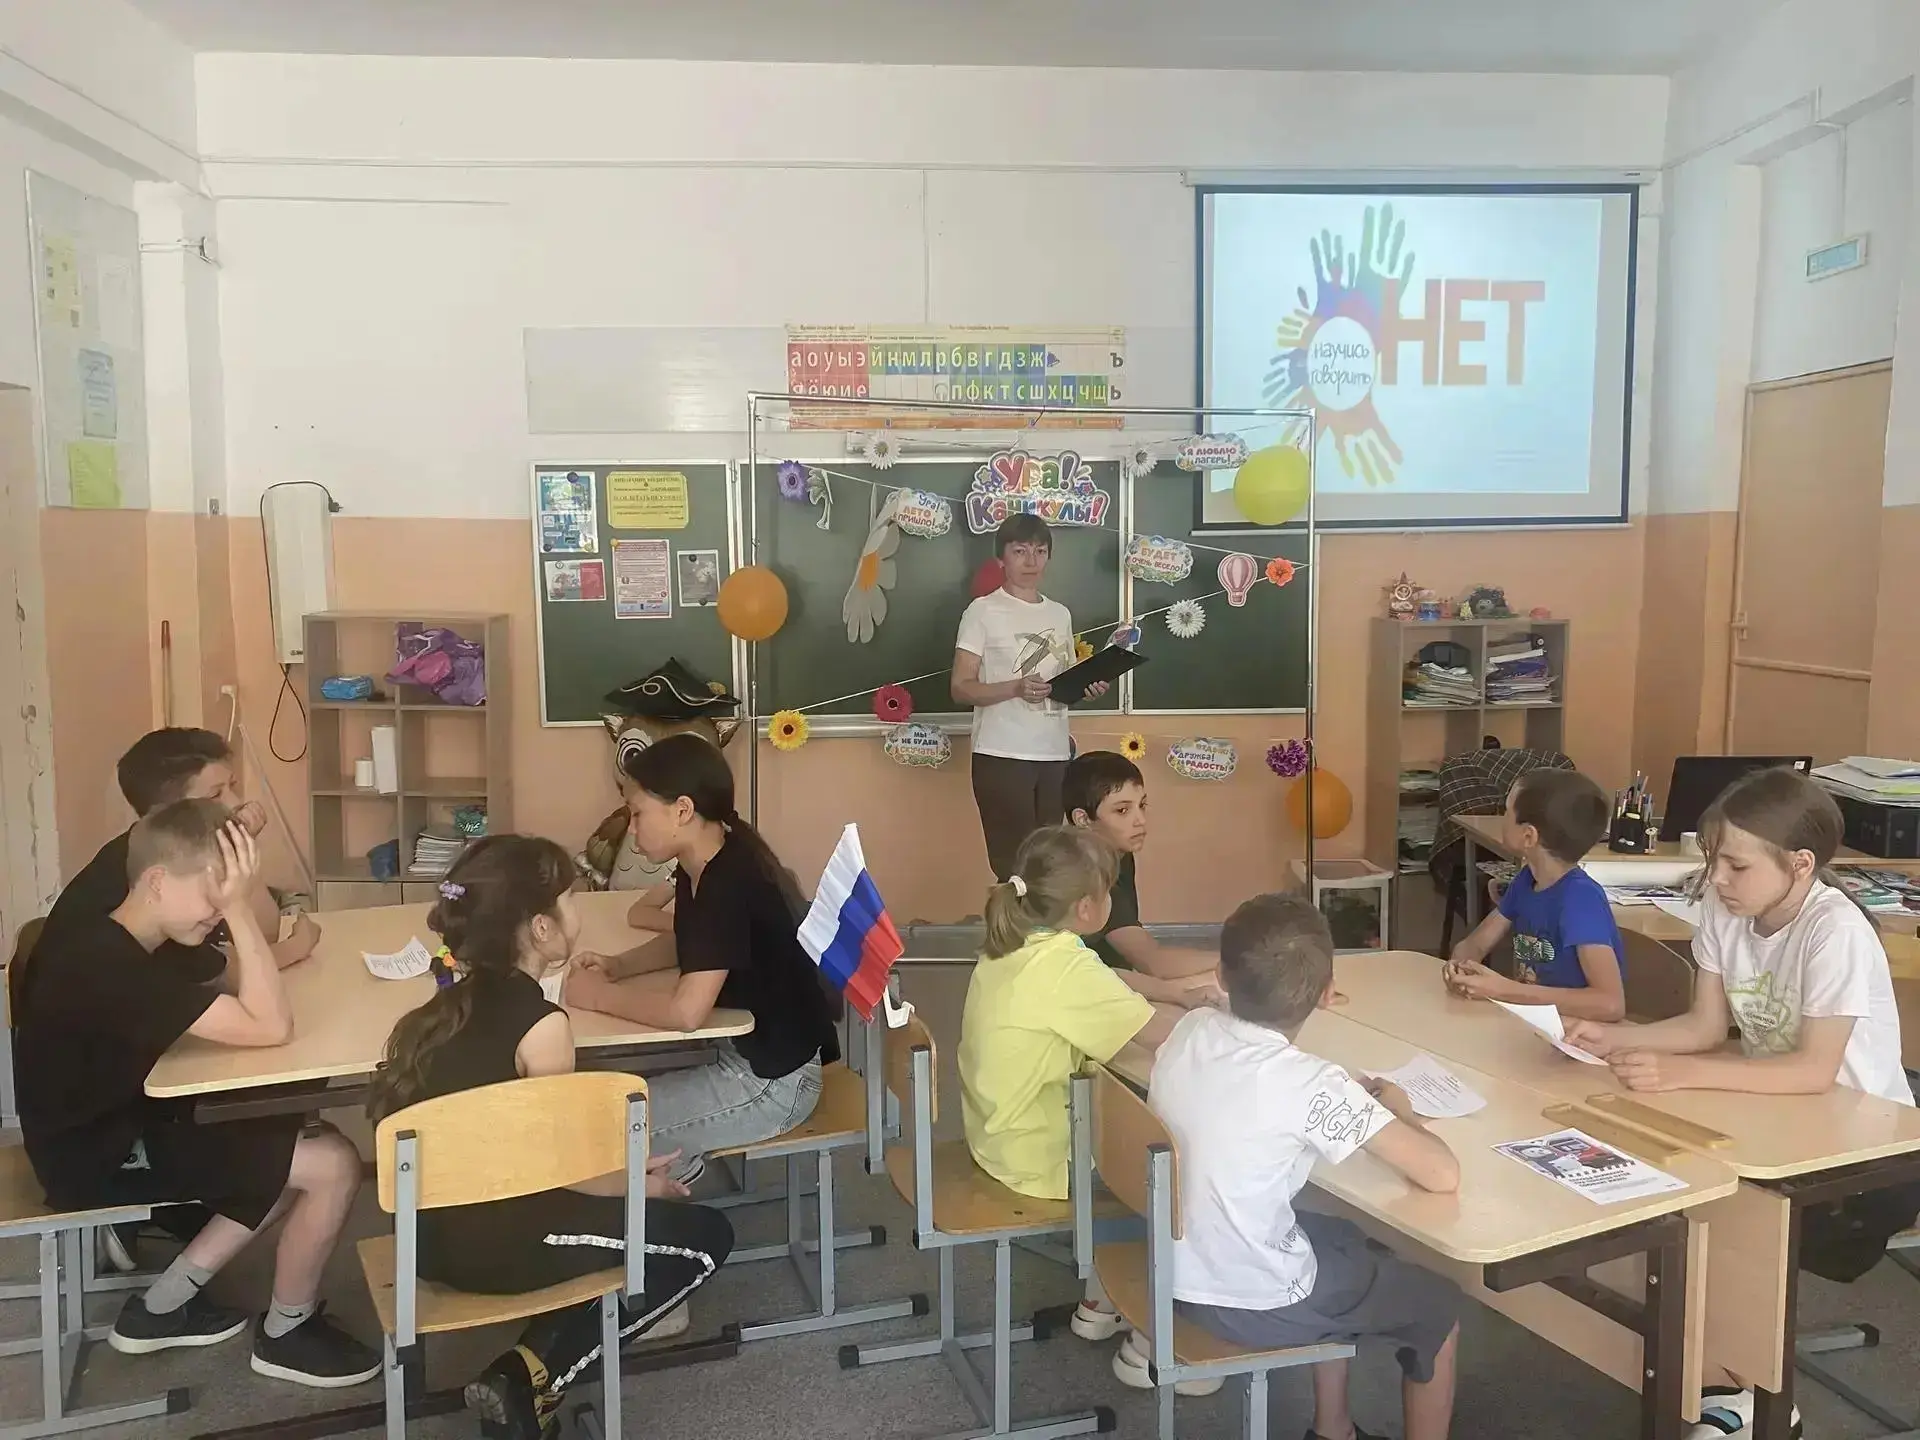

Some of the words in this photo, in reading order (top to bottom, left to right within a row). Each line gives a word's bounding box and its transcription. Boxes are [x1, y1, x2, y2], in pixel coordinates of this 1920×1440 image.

[1380, 277, 1546, 387] НЕТ
[1313, 342, 1370, 369] научись
[1311, 363, 1372, 396] говорить
[1187, 448, 1194, 456] Я
[1196, 447, 1237, 456] ЛЮБЛЮ
[995, 454, 1076, 493] Ура!
[971, 493, 1105, 527] Каникулы!
[1140, 547, 1178, 561] БУДЕТ
[913, 731, 928, 739] МЫ
[913, 738, 938, 746] БУДЕМ
[1304, 1091, 1375, 1145] BGA
